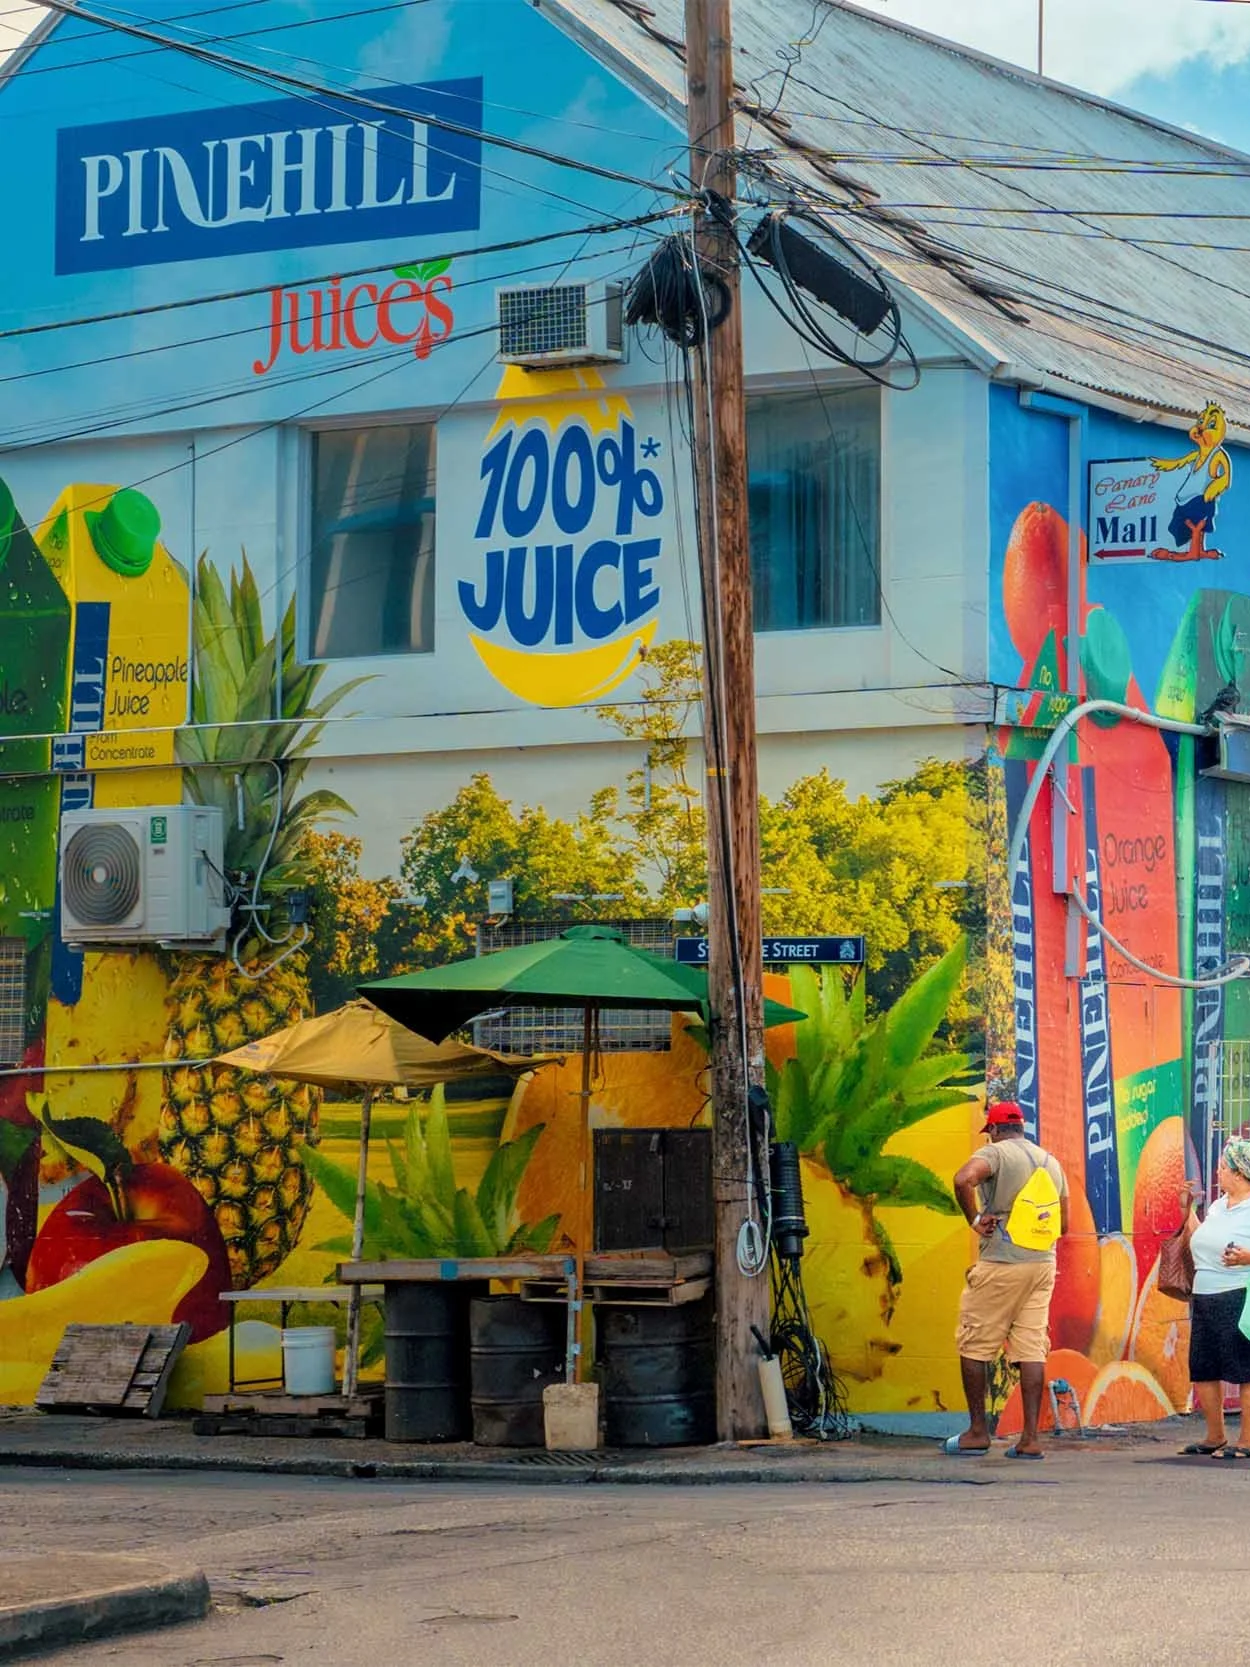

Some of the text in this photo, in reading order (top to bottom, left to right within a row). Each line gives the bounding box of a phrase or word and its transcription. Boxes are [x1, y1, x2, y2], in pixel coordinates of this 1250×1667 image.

[80, 113, 456, 241] PINEHILL
[253, 272, 455, 375] Juices
[1095, 473, 1160, 496] Canary
[1105, 492, 1157, 513] Lane
[1095, 515, 1157, 544] Mall
[458, 538, 661, 646] JUICE
[111, 655, 188, 690] Pineapple
[109, 689, 150, 716] Juice
[1104, 832, 1166, 873] Orange
[1108, 878, 1148, 915] Juice
[1083, 849, 1113, 1160] PINEHILL
